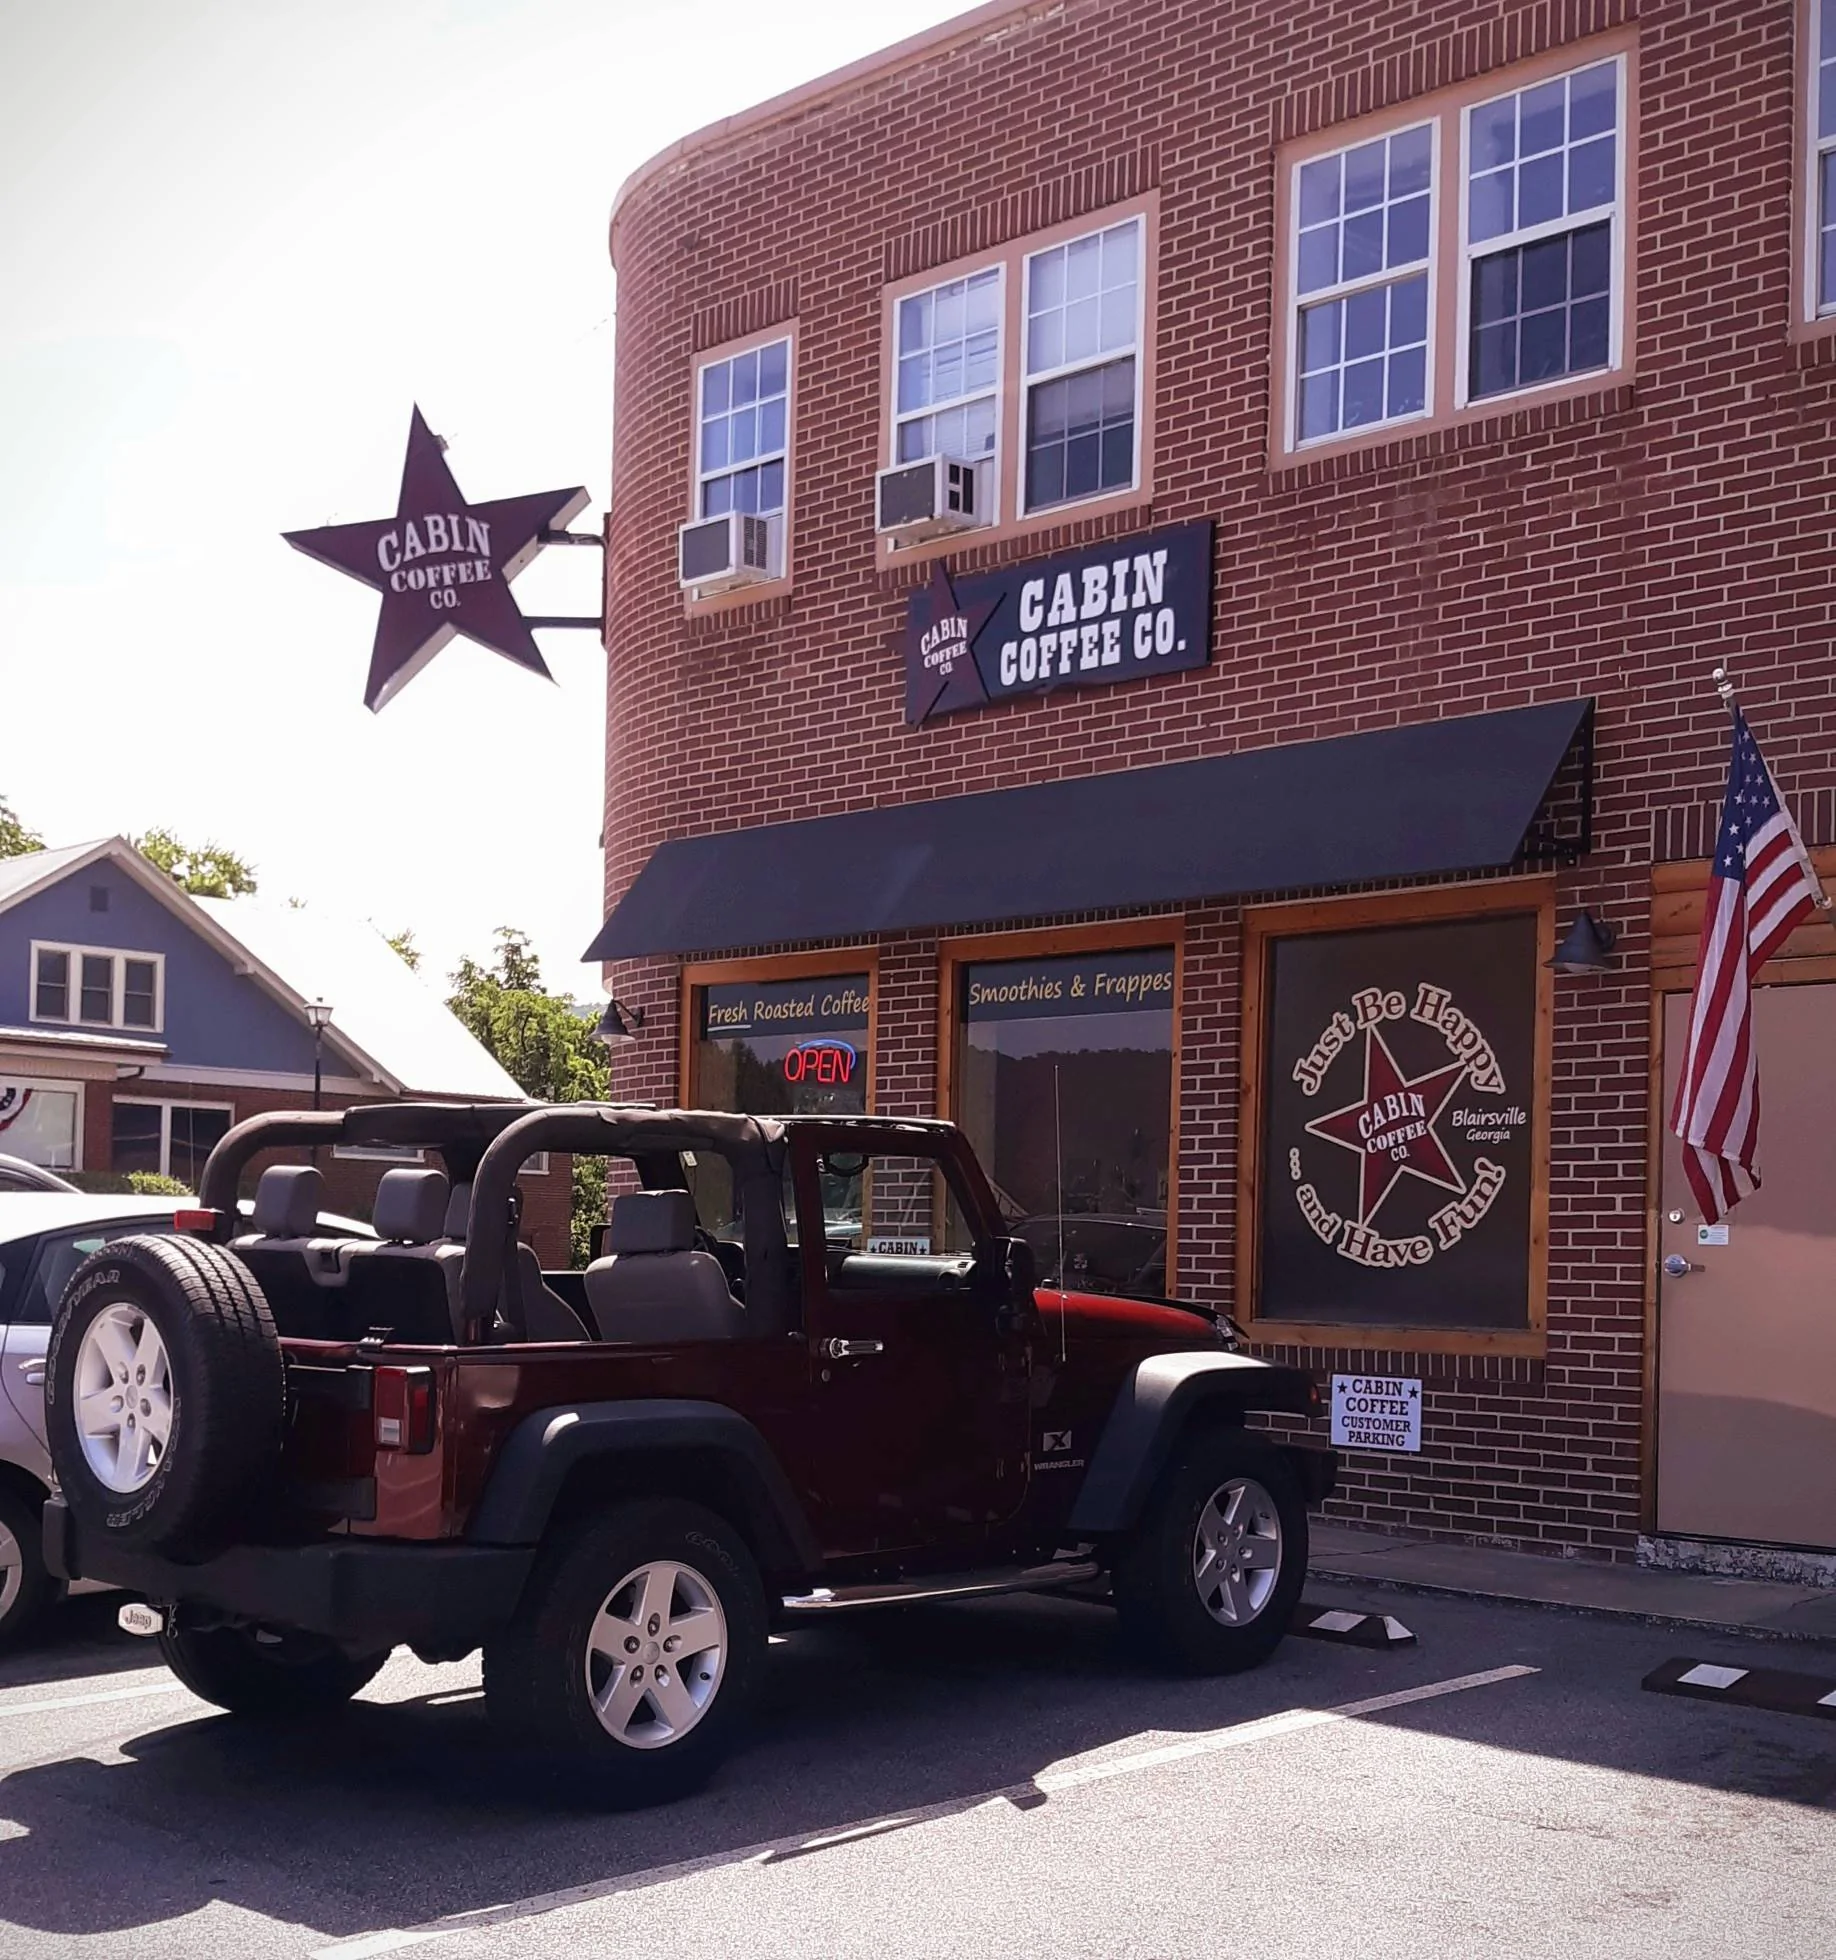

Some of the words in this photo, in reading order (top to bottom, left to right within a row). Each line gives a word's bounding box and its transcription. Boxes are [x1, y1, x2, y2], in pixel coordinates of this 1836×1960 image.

[377, 514, 491, 573] CABIN
[390, 559, 492, 593] COFFEE
[1019, 548, 1168, 633] CABIN
[429, 589, 461, 610] CO.
[921, 616, 968, 656] CABIN
[1000, 618, 1121, 686] COFFEE
[1133, 607, 1186, 660] CO.
[924, 640, 968, 669] COFFEE
[969, 975, 1063, 1006] Smoothies
[1070, 974, 1086, 998] &
[1094, 971, 1173, 1003] Frappes
[708, 1000, 748, 1025] Fresh
[754, 995, 815, 1021] Roasted
[820, 989, 869, 1016] Coffee
[1292, 1012, 1356, 1096] Just
[1352, 987, 1406, 1029] Be
[1410, 982, 1506, 1095] Happy
[785, 1047, 852, 1084] OPEN
[1358, 1091, 1425, 1140] CABIN
[1452, 1107, 1527, 1127] Blairsville
[1366, 1119, 1428, 1154] COFFEE
[1466, 1128, 1511, 1144] Georgia
[1296, 1183, 1342, 1244] and
[1337, 1220, 1433, 1268] Have
[1428, 1157, 1506, 1250] Fun!
[878, 1241, 918, 1255] CABIN
[1352, 1379, 1404, 1396] CABIN
[1345, 1397, 1409, 1416] COFFEE
[1341, 1415, 1412, 1433] CUSTOMER
[1348, 1430, 1405, 1447] PARKING
[1033, 1459, 1085, 1470] WRANGLER
[125, 1609, 152, 1630] Jeep
